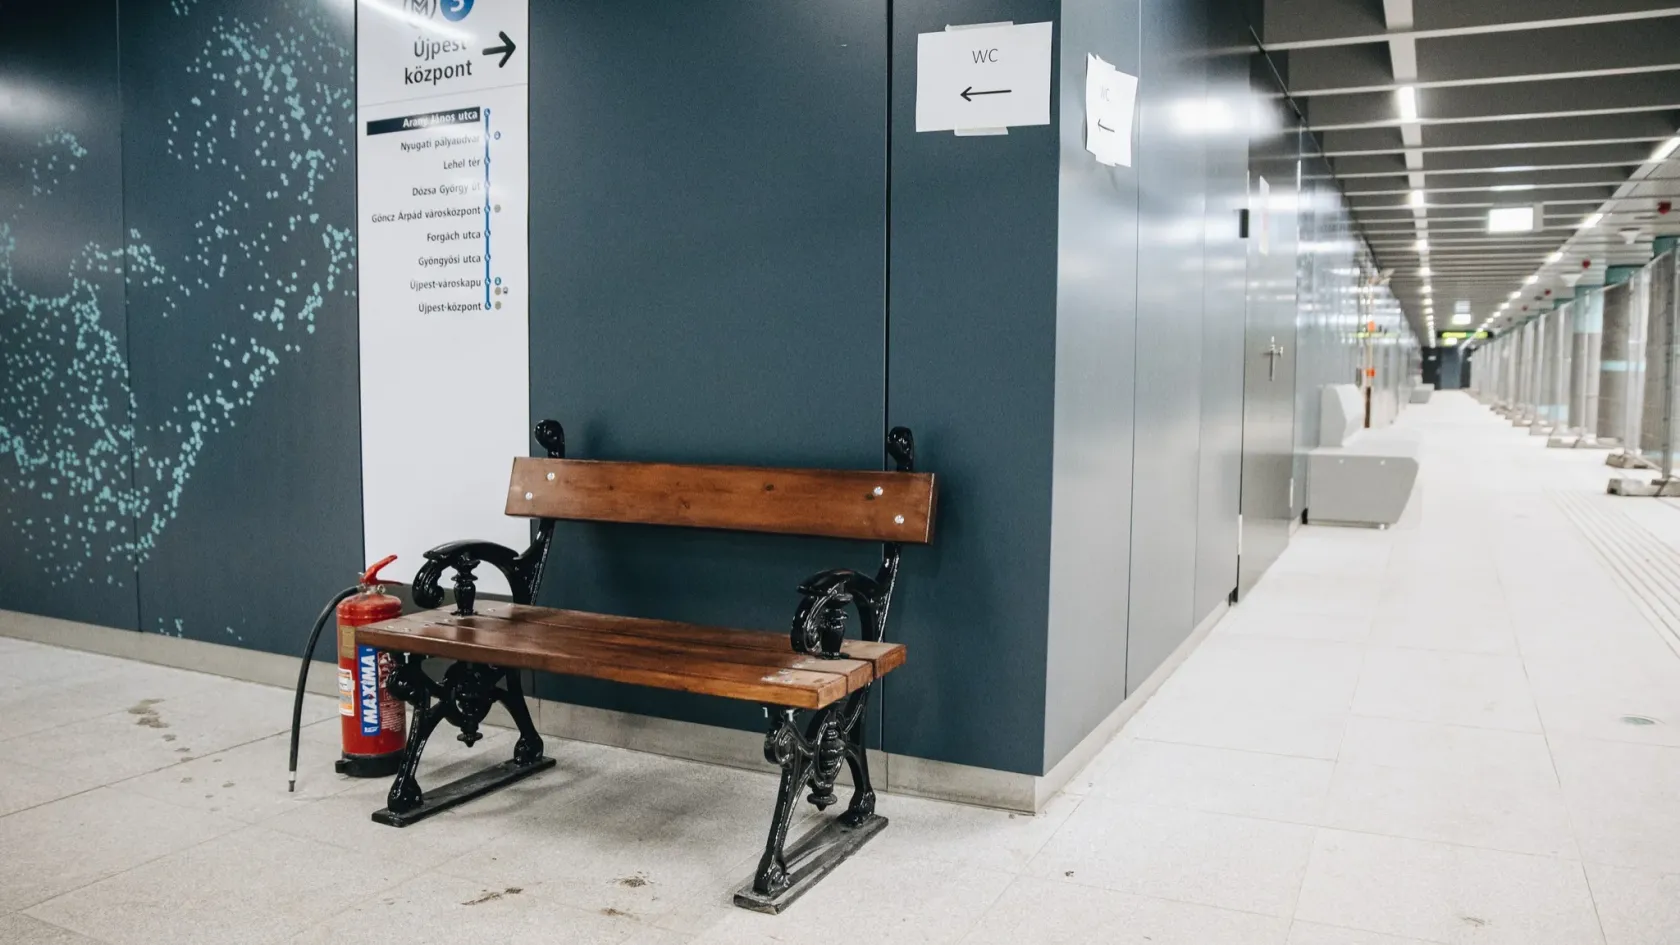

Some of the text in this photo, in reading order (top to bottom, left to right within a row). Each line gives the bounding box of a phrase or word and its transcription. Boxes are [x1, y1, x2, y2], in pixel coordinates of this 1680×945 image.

[413, 36, 467, 61] Újpest
[971, 48, 998, 63] WC
[404, 60, 473, 86] központ
[458, 110, 478, 121] utca
[401, 135, 480, 152] Nyugati pályaudvar
[443, 157, 480, 170] Lehel tér
[412, 184, 437, 197] Dózsa
[439, 183, 469, 196] György
[371, 205, 481, 224] Göncz Árpád városközpont
[426, 230, 481, 244] Forgách utca
[418, 254, 481, 268] Gyöngyösi utca
[409, 277, 481, 292] Újpest-városkapu
[418, 301, 481, 315] Újpest-központ
[360, 654, 379, 725] MAXIMA
